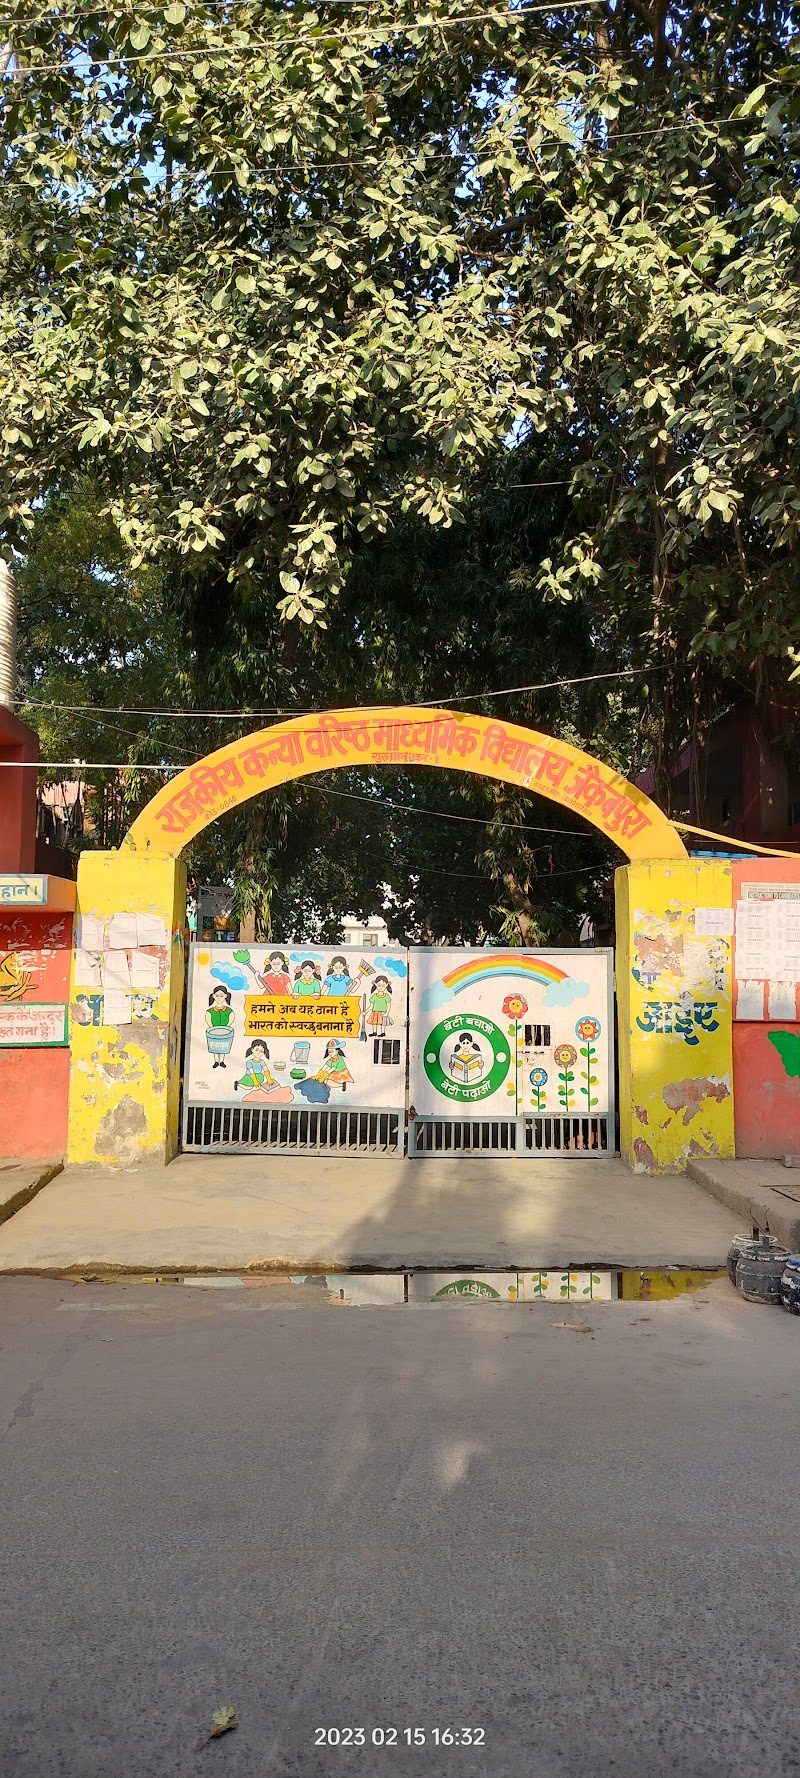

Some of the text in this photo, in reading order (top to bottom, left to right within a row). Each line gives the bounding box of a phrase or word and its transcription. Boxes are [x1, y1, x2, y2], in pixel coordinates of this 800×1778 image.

[155, 764, 244, 833] राजकीय
[238, 731, 303, 778] कन्या
[305, 715, 370, 757] वरिष्ठ
[372, 714, 480, 757] माध्यमिक
[479, 724, 574, 789] विद्यालय
[251, 1001, 350, 1019] हमने अब यह ठाना है
[248, 1021, 274, 1031] भारत
[274, 1018, 288, 1030] को
[316, 1022, 344, 1031] बनाना
[345, 1018, 355, 1035] है
[443, 1016, 495, 1035] बेटी बचाओ
[441, 1079, 492, 1100] बेटी पढ़ाओ
